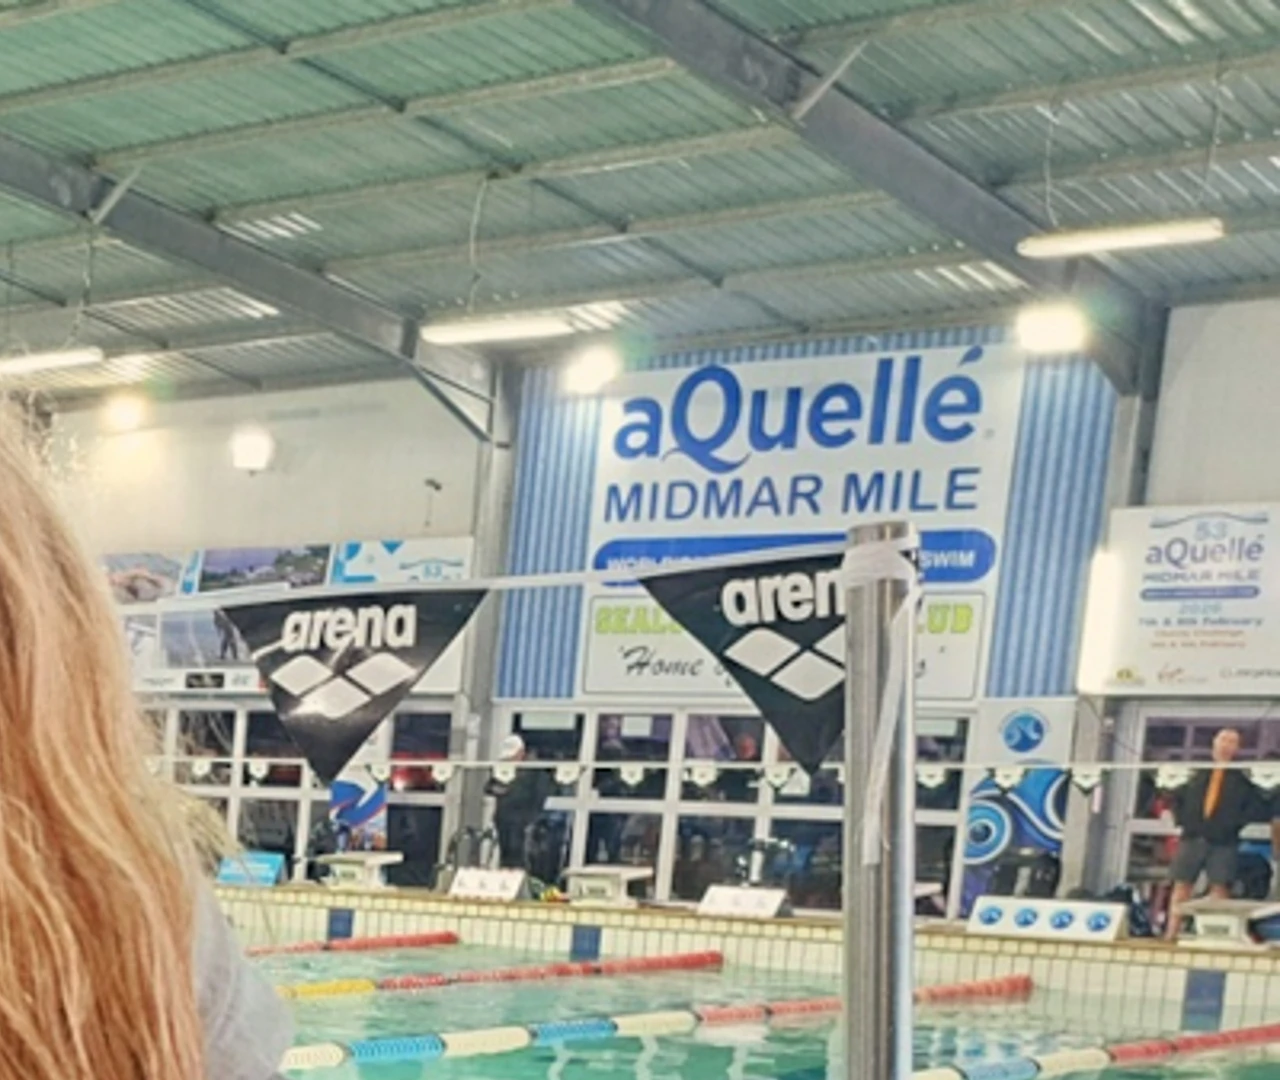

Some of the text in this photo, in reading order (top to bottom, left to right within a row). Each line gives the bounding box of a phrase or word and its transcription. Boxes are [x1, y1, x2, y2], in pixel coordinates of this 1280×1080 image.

[613, 345, 985, 474] aQuellé
[603, 465, 982, 523] MIDMAR MILE
[281, 603, 418, 652] arena
[721, 570, 846, 629] aren
